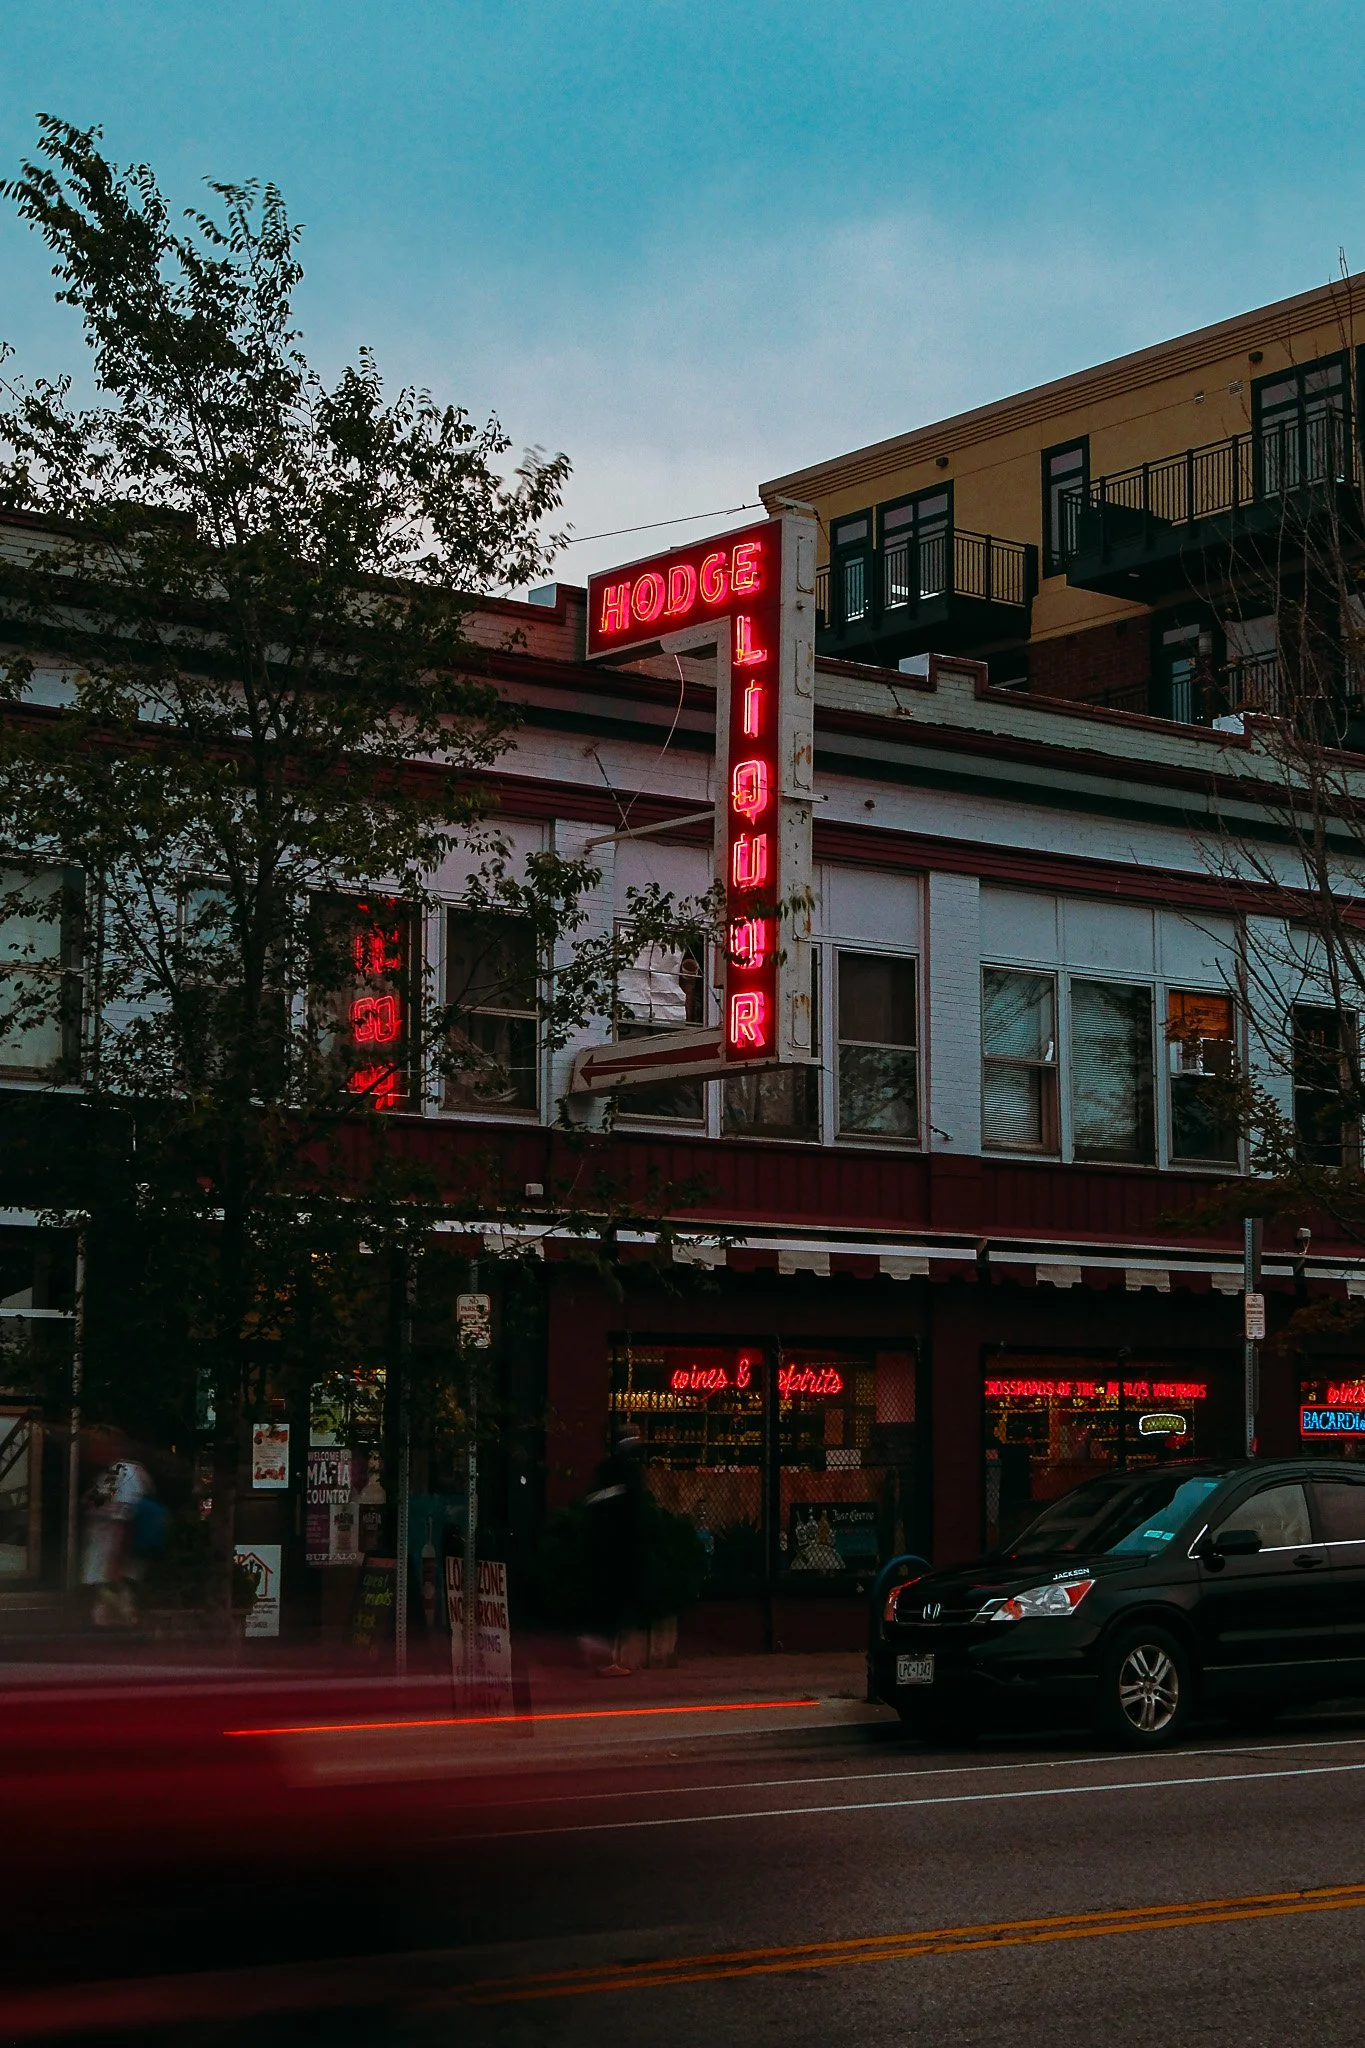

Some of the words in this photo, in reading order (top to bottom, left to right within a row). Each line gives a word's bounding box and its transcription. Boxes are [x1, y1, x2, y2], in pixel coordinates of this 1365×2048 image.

[598, 541, 763, 633] HODGE
[729, 614, 769, 1049] LIQUOR
[670, 1364, 729, 1389] wines
[735, 1357, 751, 1389] &
[778, 1363, 843, 1400] spirits
[307, 1451, 340, 1461] WELCOME
[306, 1461, 351, 1489] MAFIA
[306, 1489, 351, 1504] COUNTRY
[305, 1553, 357, 1561] BUFFALO
[475, 1561, 505, 1597] ZONE
[1052, 1568, 1090, 1581] JACKSON
[449, 1596, 464, 1624] NO
